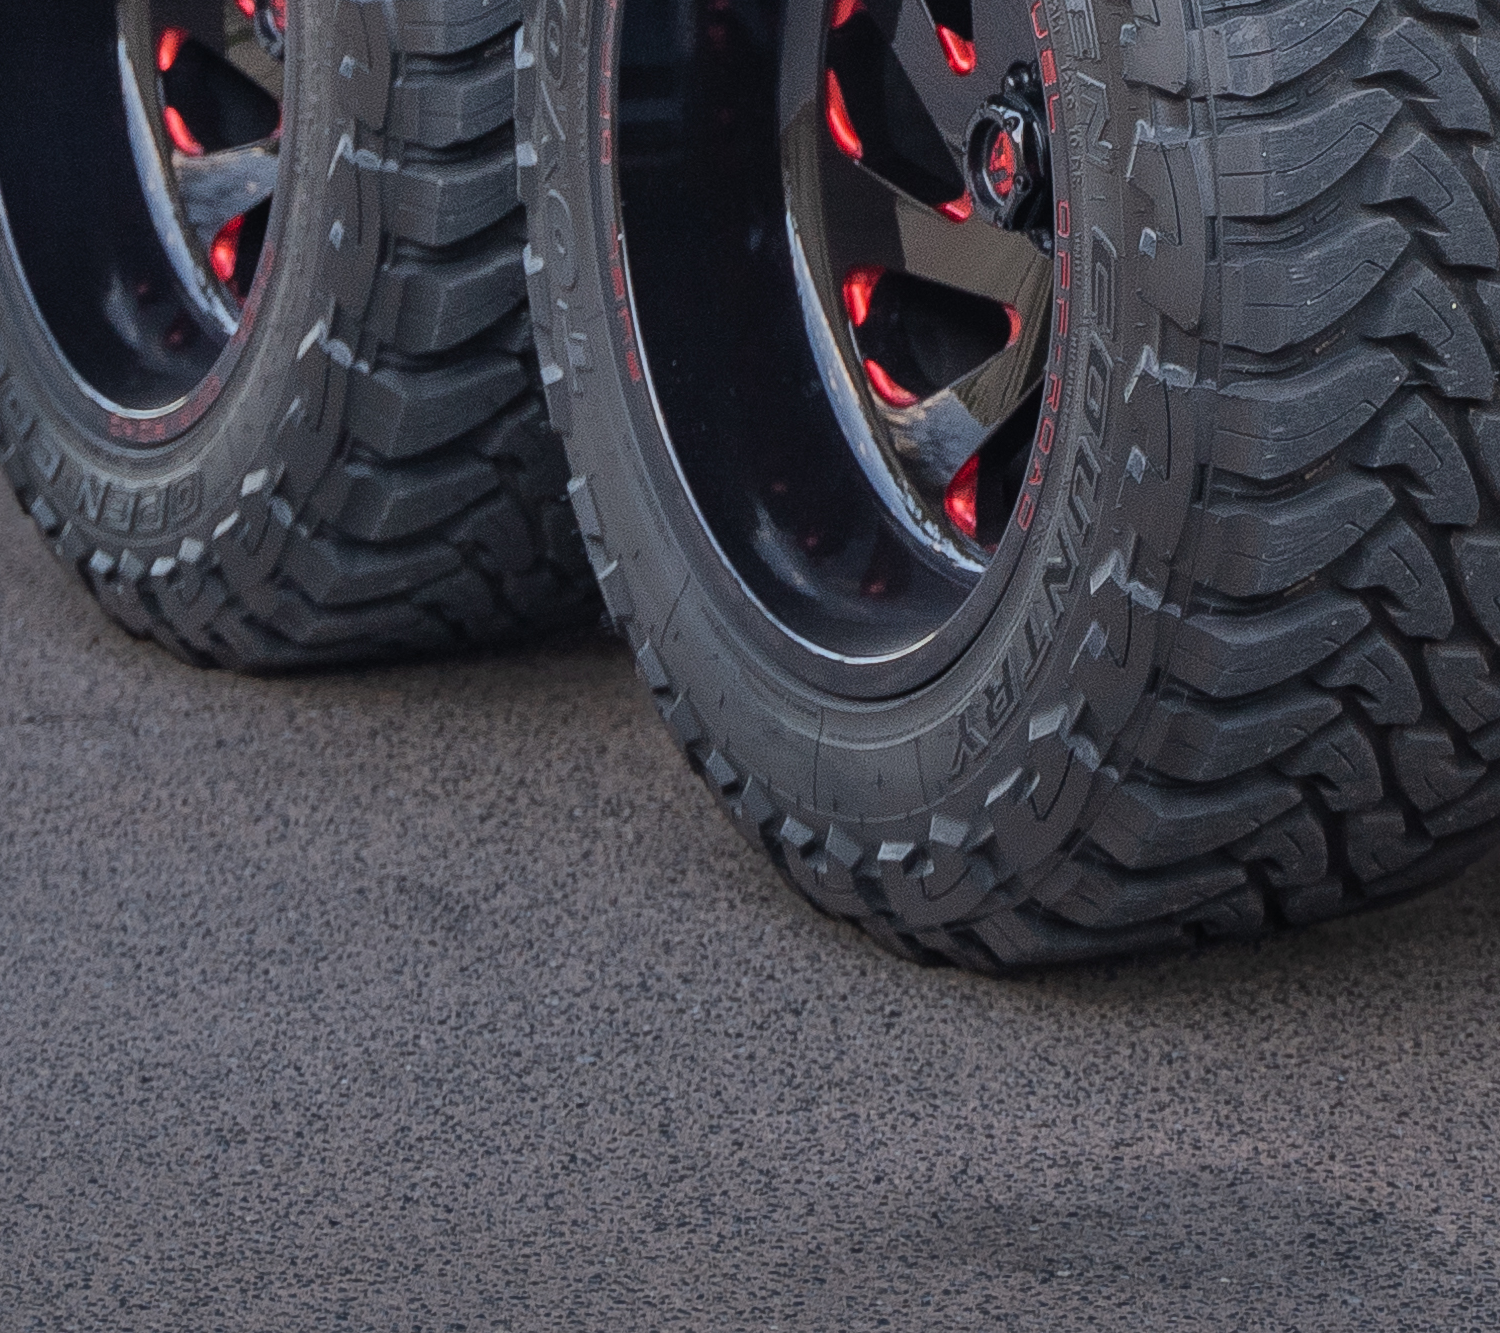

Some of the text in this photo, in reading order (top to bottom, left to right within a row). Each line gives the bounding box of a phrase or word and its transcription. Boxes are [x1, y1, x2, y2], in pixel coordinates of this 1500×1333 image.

[73, 466, 205, 536] OPEN
[946, 223, 1118, 779] COUNTRY
[1014, 199, 1070, 537] OFF-ROAD
